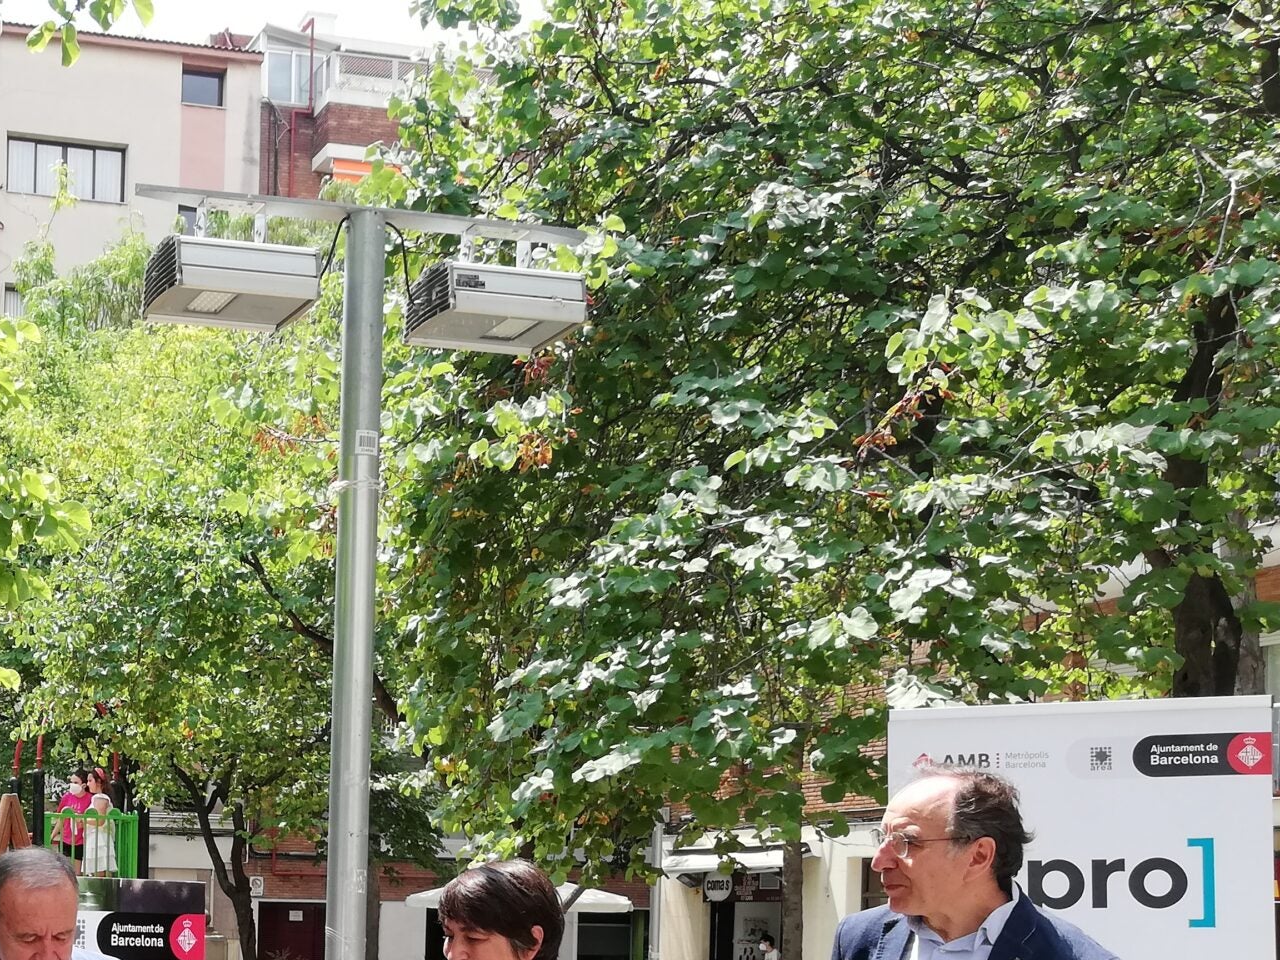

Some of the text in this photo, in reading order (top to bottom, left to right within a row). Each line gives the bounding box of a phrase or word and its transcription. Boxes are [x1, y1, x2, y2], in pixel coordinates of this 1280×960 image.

[1150, 743, 1219, 753] Ajuntament de
[1005, 761, 1046, 769] Barcelona
[1150, 753, 1219, 766] Barcelona
[1027, 838, 1216, 928] pro]
[111, 922, 164, 935] Ajuntament de
[111, 934, 164, 947] Barcelona
